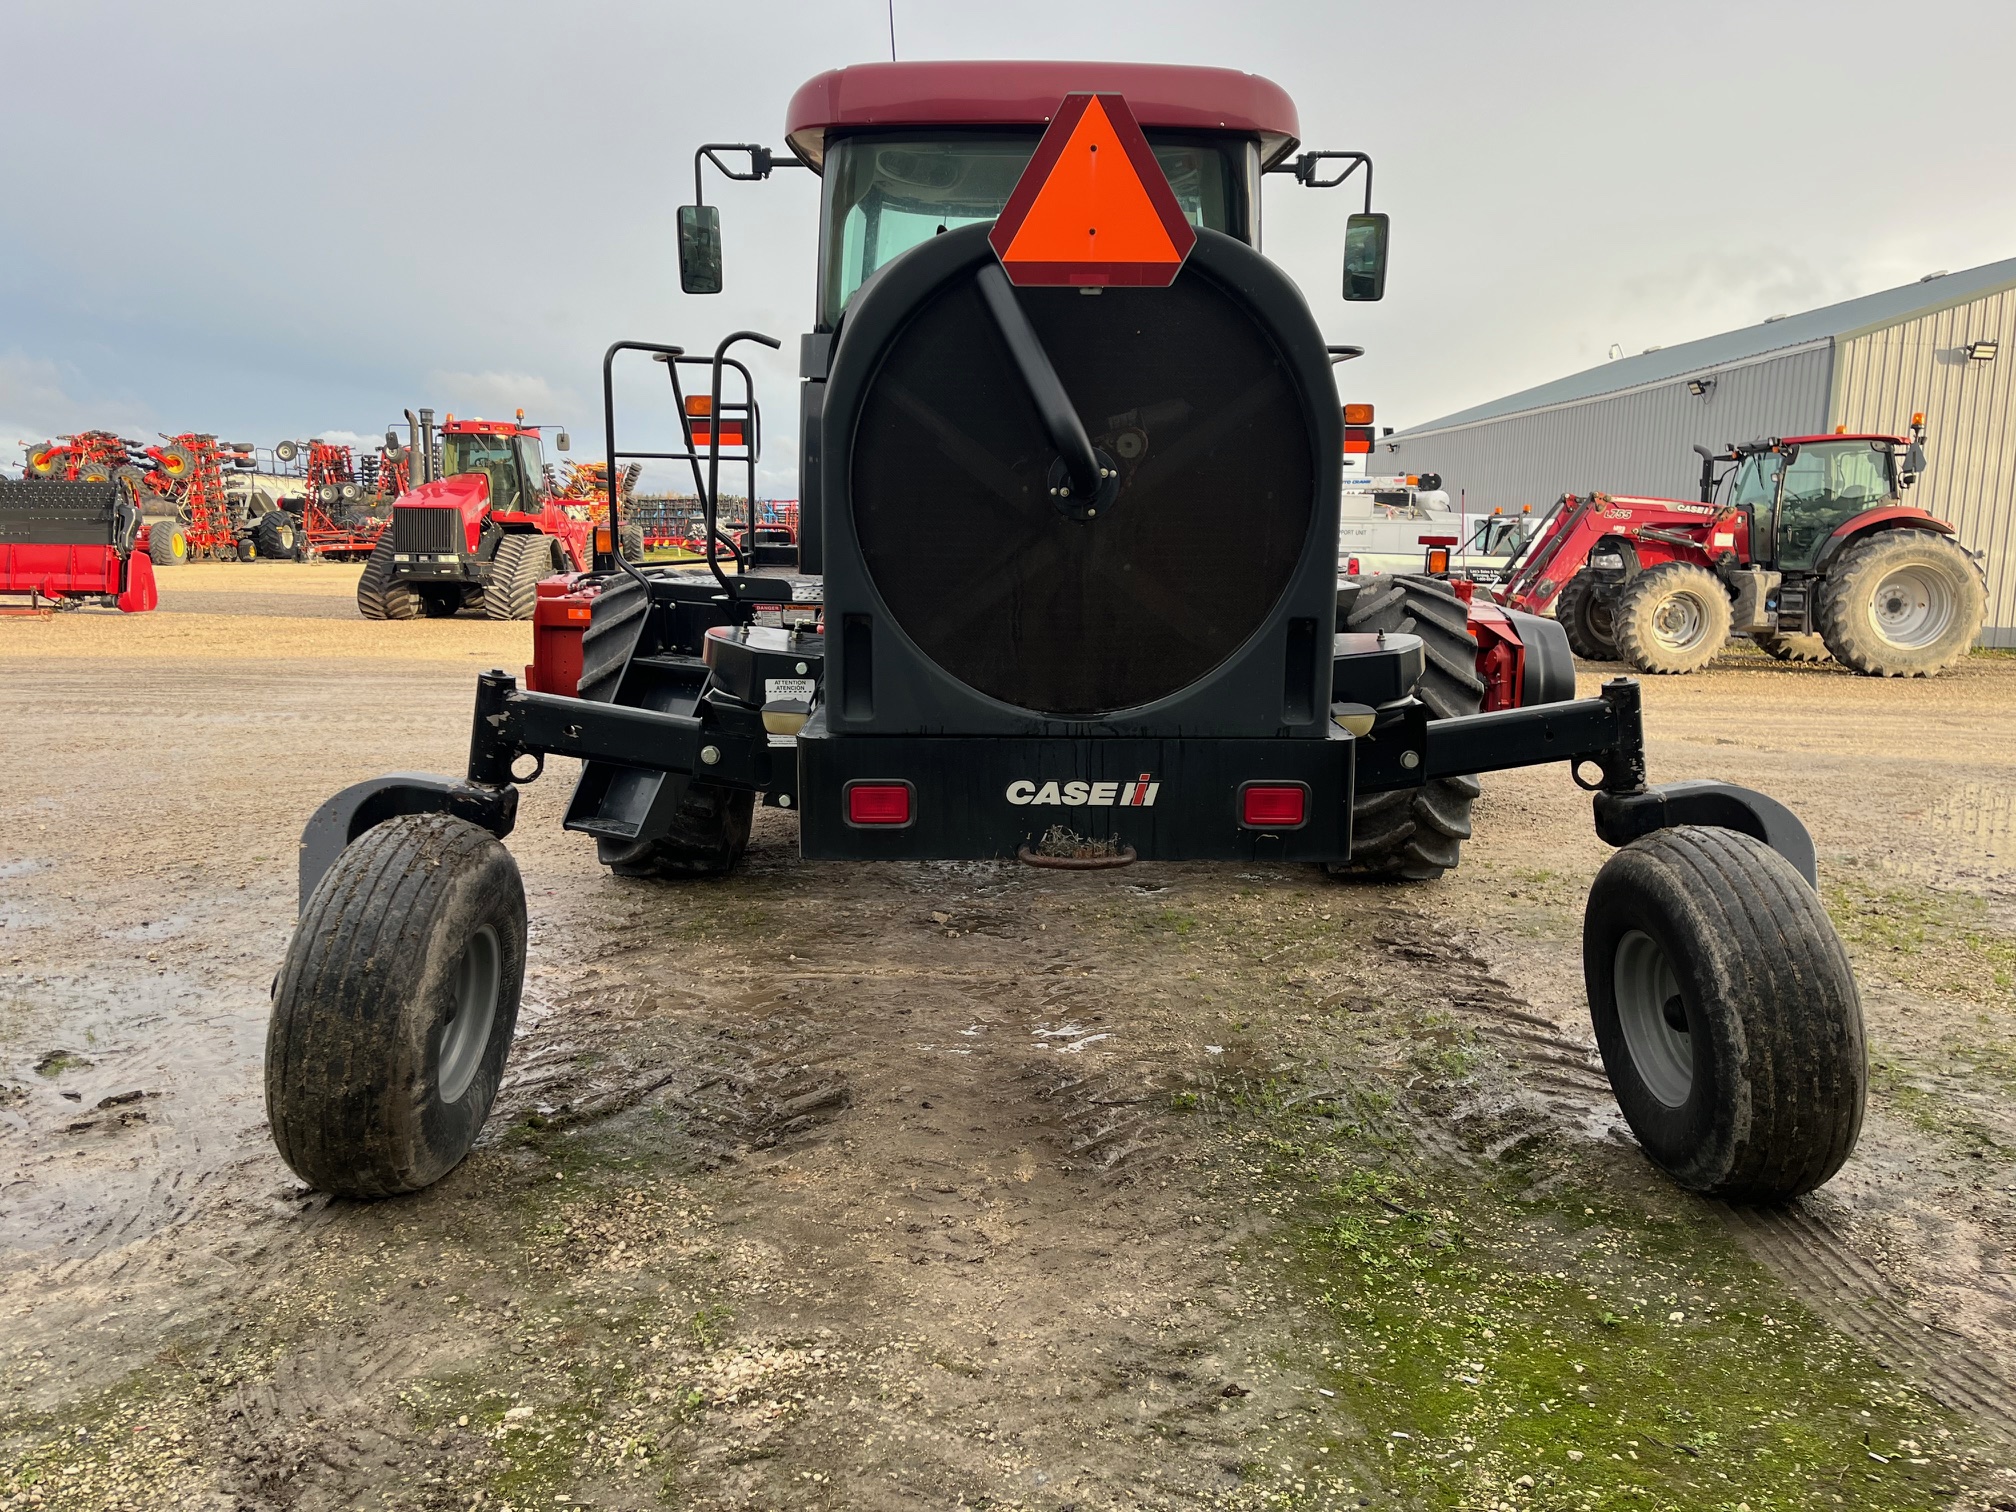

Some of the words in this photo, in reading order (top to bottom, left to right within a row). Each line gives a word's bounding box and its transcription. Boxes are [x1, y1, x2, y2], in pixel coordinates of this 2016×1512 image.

[1603, 508, 1632, 519] L755
[1677, 504, 1703, 514] CASE
[1006, 780, 1119, 806] CASE
